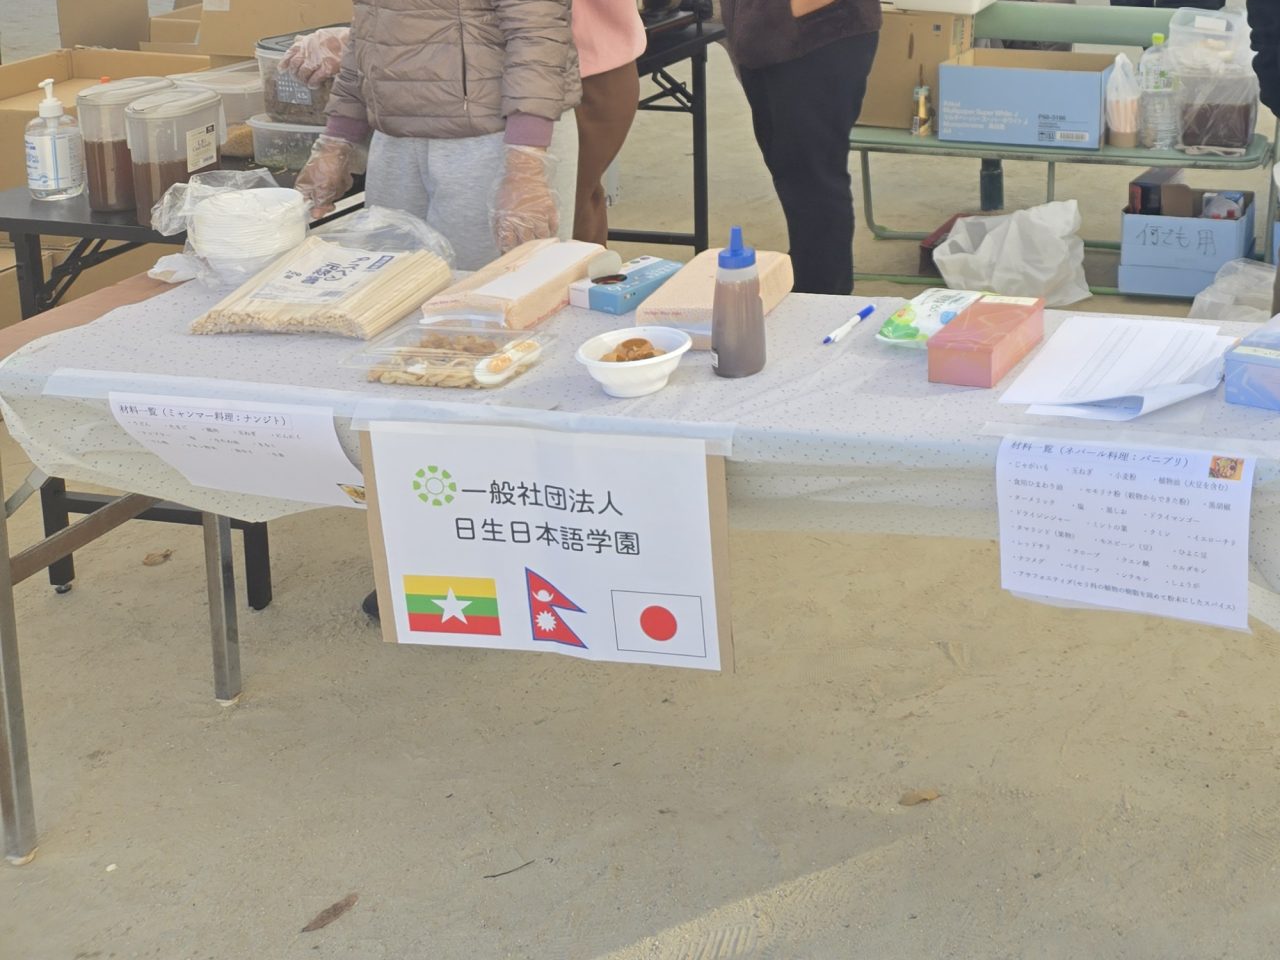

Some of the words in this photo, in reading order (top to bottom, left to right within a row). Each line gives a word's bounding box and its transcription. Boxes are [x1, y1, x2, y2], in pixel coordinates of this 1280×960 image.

[461, 480, 623, 517] 一般社団法人
[455, 516, 641, 557] 日生日本語学園
